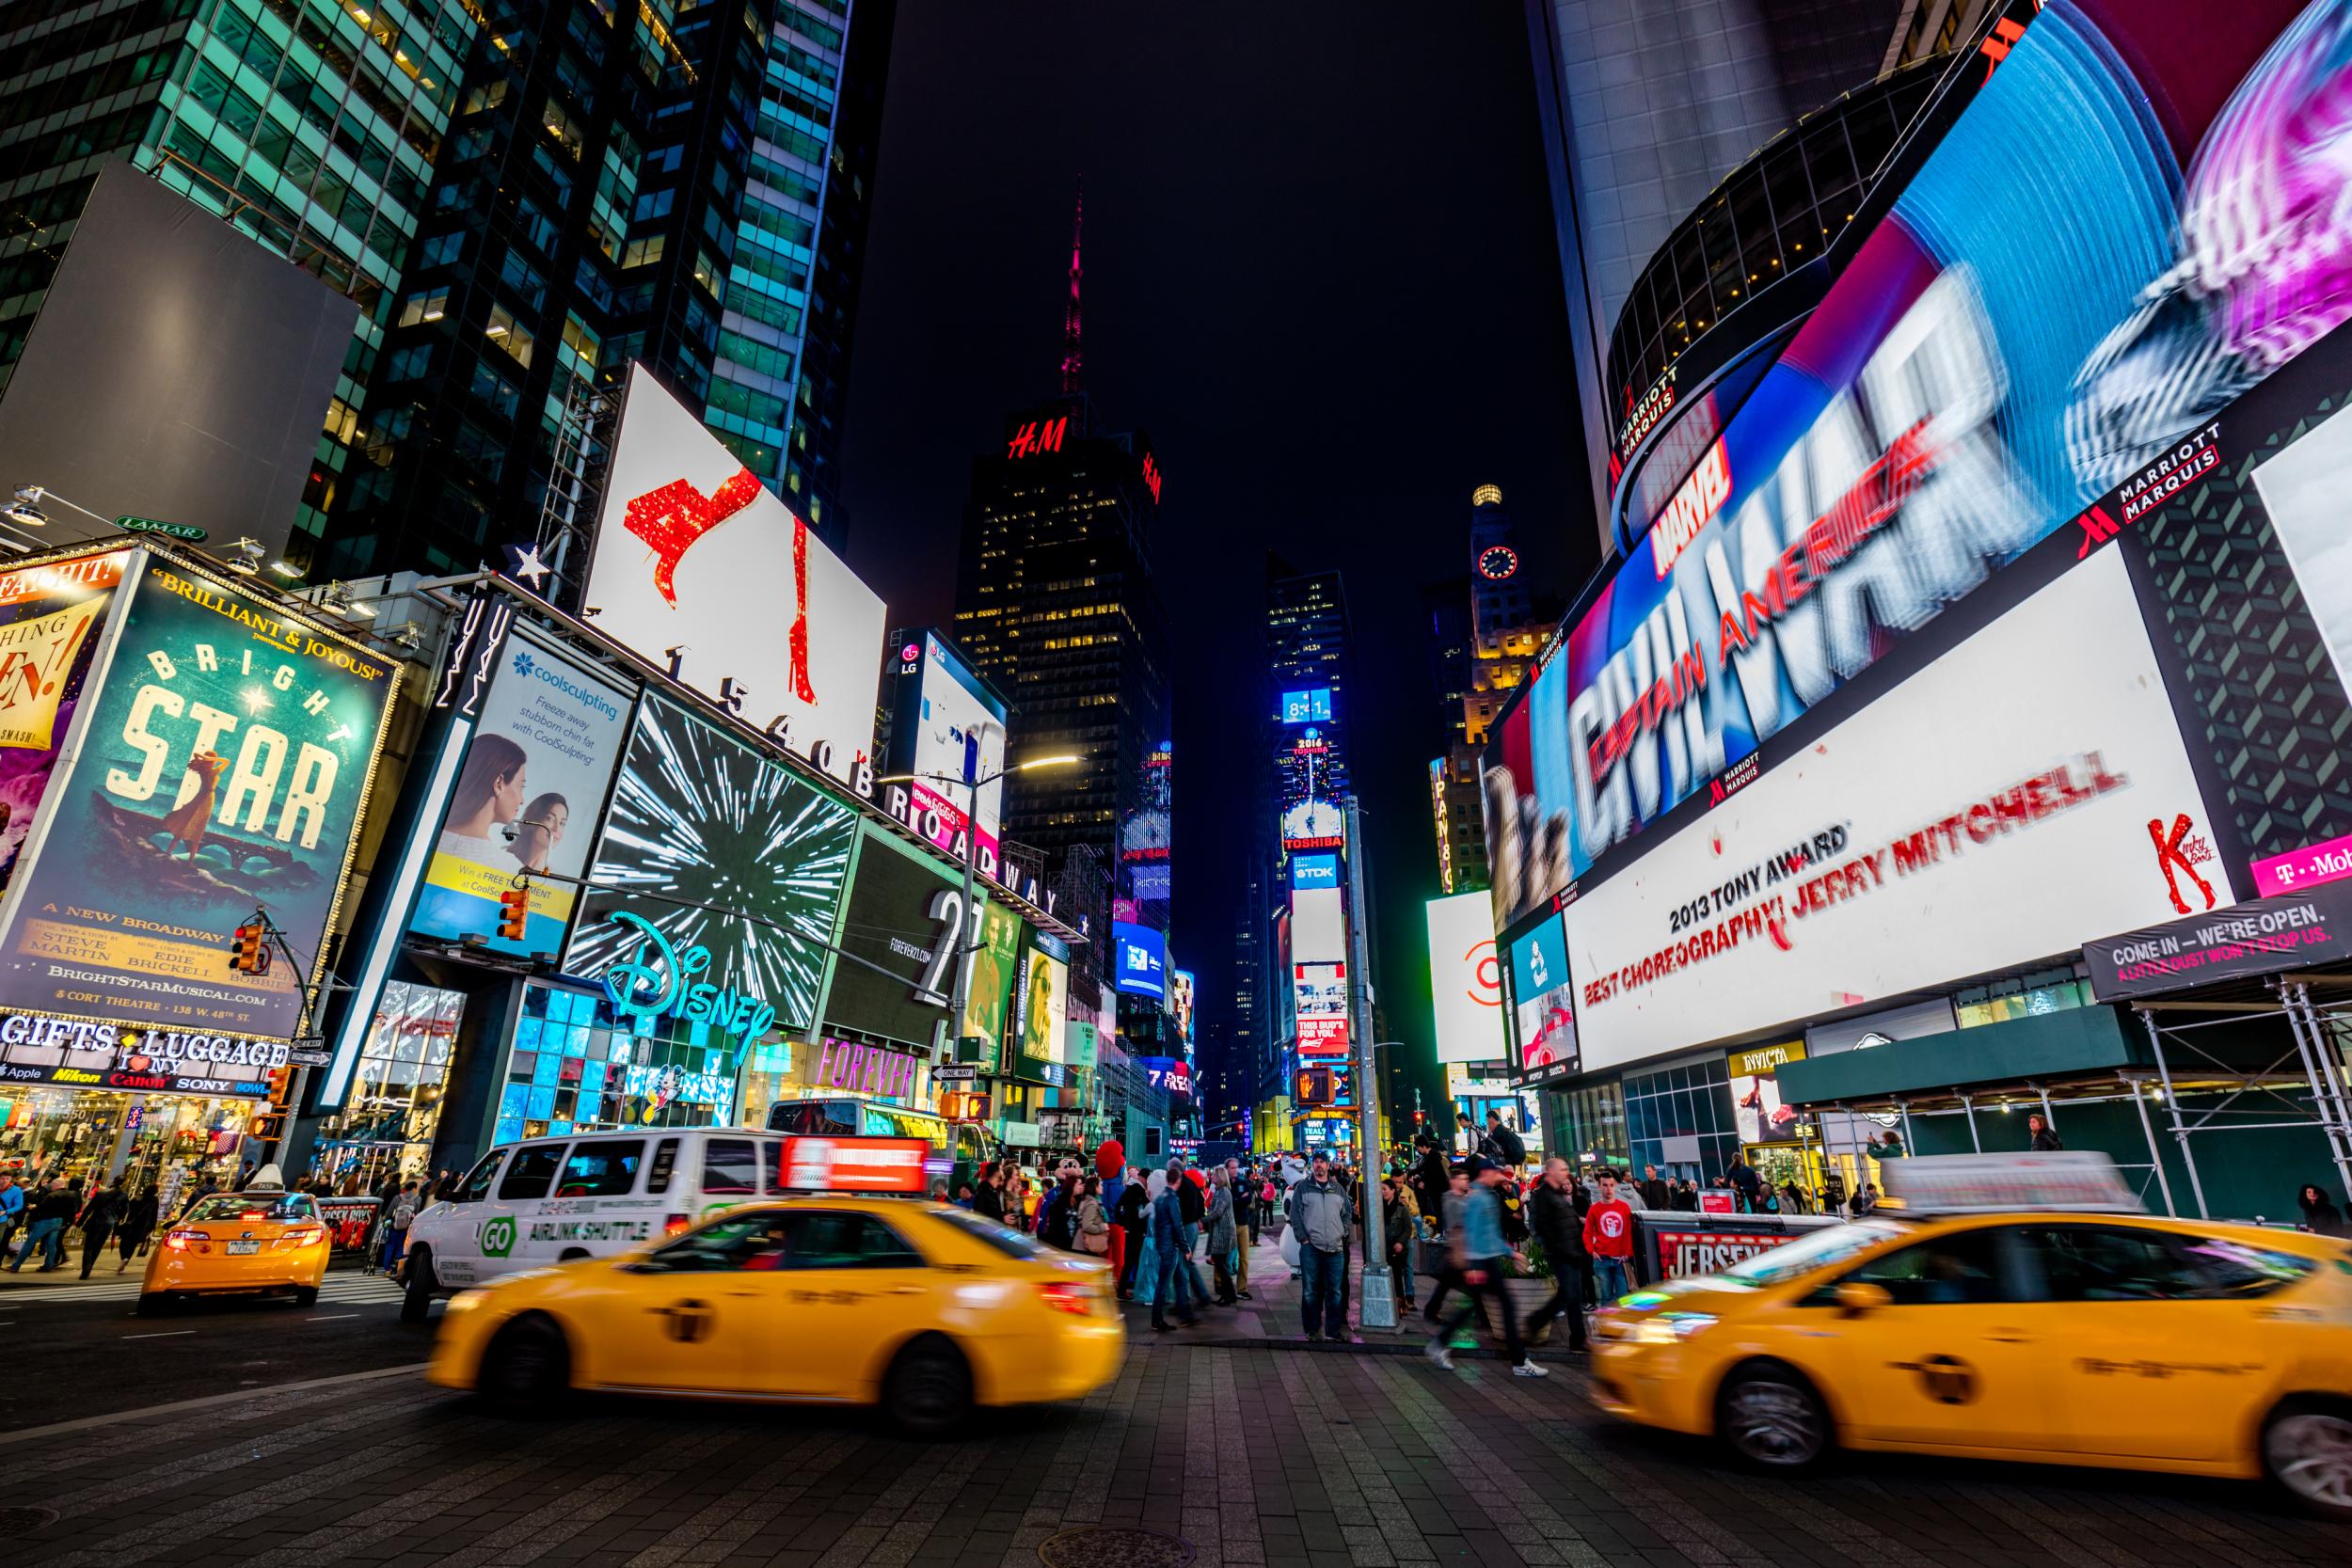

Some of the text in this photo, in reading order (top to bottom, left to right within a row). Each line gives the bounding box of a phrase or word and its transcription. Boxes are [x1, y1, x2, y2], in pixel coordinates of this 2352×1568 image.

[1620, 366, 1677, 445] MARRIOTT
[1009, 417, 1067, 459] H&M
[1623, 392, 1673, 461] MARQUIS
[2120, 422, 2220, 503] MARRIOTT
[2125, 450, 2215, 520] MARQUIS
[1650, 438, 1731, 579] MARVEL
[123, 518, 196, 536] LAMAR
[285, 630, 301, 647] &
[901, 664, 916, 674] LG
[147, 644, 354, 742] BRIGHT
[535, 666, 618, 722] coolsculpting
[535, 694, 591, 734] Freeze away
[512, 721, 532, 738] with
[520, 707, 595, 750] stubborn chin fat
[1298, 738, 1323, 749] 2016
[105, 685, 339, 848] STAR
[1724, 752, 1759, 783] MARRIOTT
[1726, 767, 1757, 793] MARQUIS
[1285, 836, 1342, 848] TOSHIBA
[459, 865, 475, 877] Win
[484, 872, 504, 886] FREE
[1305, 867, 1333, 878] TDK
[1584, 971, 1619, 1008] BEST
[1791, 847, 1886, 919] JERRY
[1891, 750, 2132, 879] MITCHELL
[1670, 895, 1709, 934] 2013
[1709, 864, 1760, 912] TONY
[42, 902, 225, 943] A NEW BROADWAY
[2113, 941, 2160, 965] COME
[2160, 936, 2180, 955] IN
[2260, 904, 2325, 933] OPEN.
[30, 941, 111, 961] MARTIN
[41, 931, 107, 950] STEVE
[889, 937, 932, 964] FOREVER21.COM
[2170, 950, 2205, 971] DUST
[2258, 931, 2299, 953] STOP
[2301, 926, 2332, 945] US.
[154, 952, 195, 965] EDIE
[230, 974, 285, 988] BOBBIE
[67, 991, 102, 1004] CORT
[105, 997, 161, 1011] THEATRE
[173, 1006, 191, 1015] 138
[1298, 1021, 1317, 1030] THIS
[1299, 1029, 1336, 1038] FOR YOU.
[1, 1015, 290, 1068] GIFTS LUGGAGE
[148, 1058, 184, 1076] NY
[816, 1037, 916, 1097] FOREVER
[1742, 1047, 1788, 1072] INVICTA
[8, 1067, 41, 1079] Apple
[52, 1068, 102, 1083] Nikon
[109, 1072, 167, 1088] Canon
[176, 1078, 230, 1091] SONY
[958, 1069, 970, 1077] WAY
[128, 1108, 139, 1128] ATM
[484, 1222, 512, 1250] GO
[529, 1222, 580, 1241] AIRLINK
